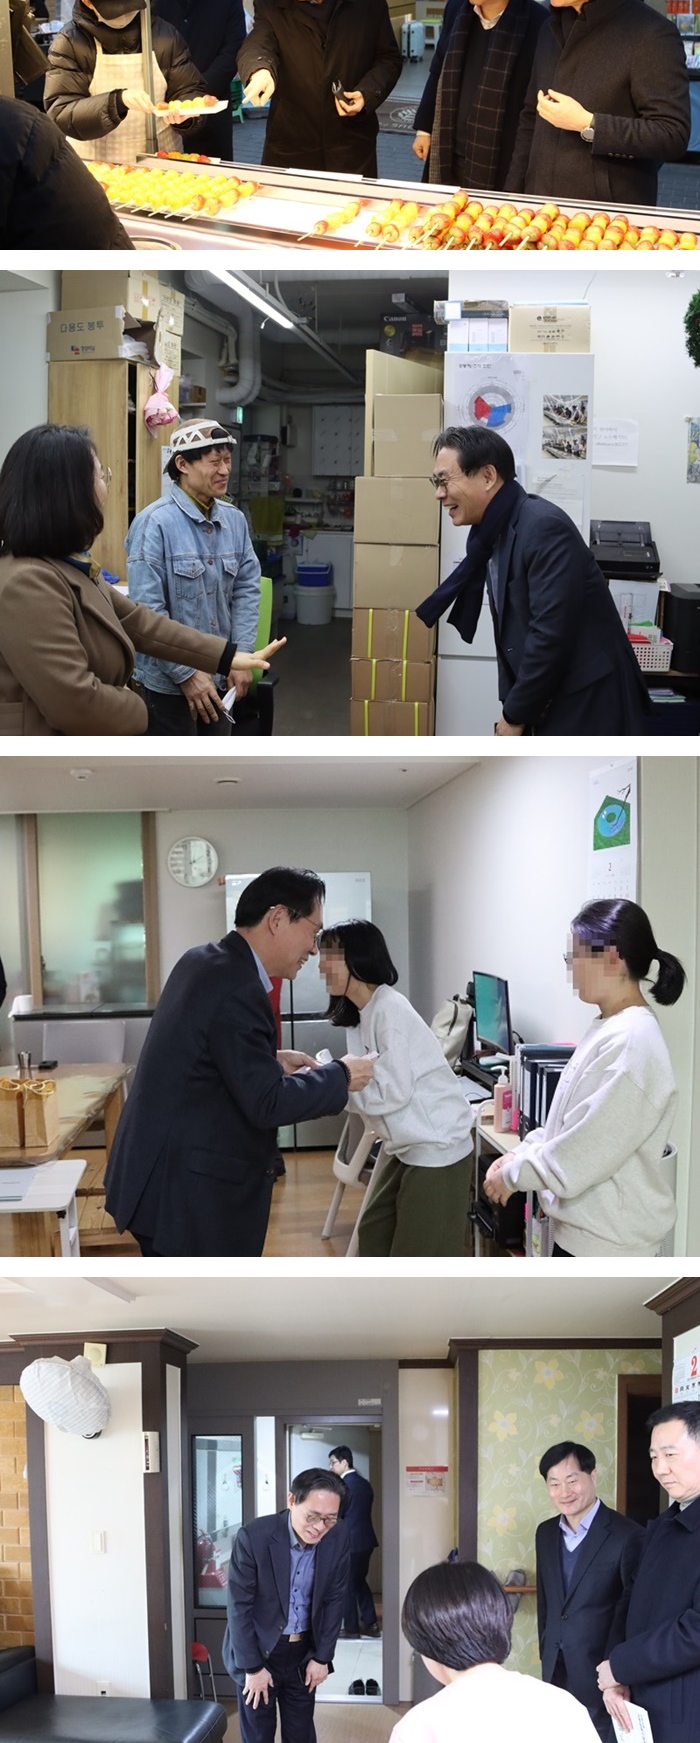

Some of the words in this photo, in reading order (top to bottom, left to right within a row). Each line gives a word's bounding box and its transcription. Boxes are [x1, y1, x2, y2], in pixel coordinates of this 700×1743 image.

[60, 322, 85, 333] 다용도
[87, 320, 105, 331] 봉투
[690, 1355, 698, 1377] 2
